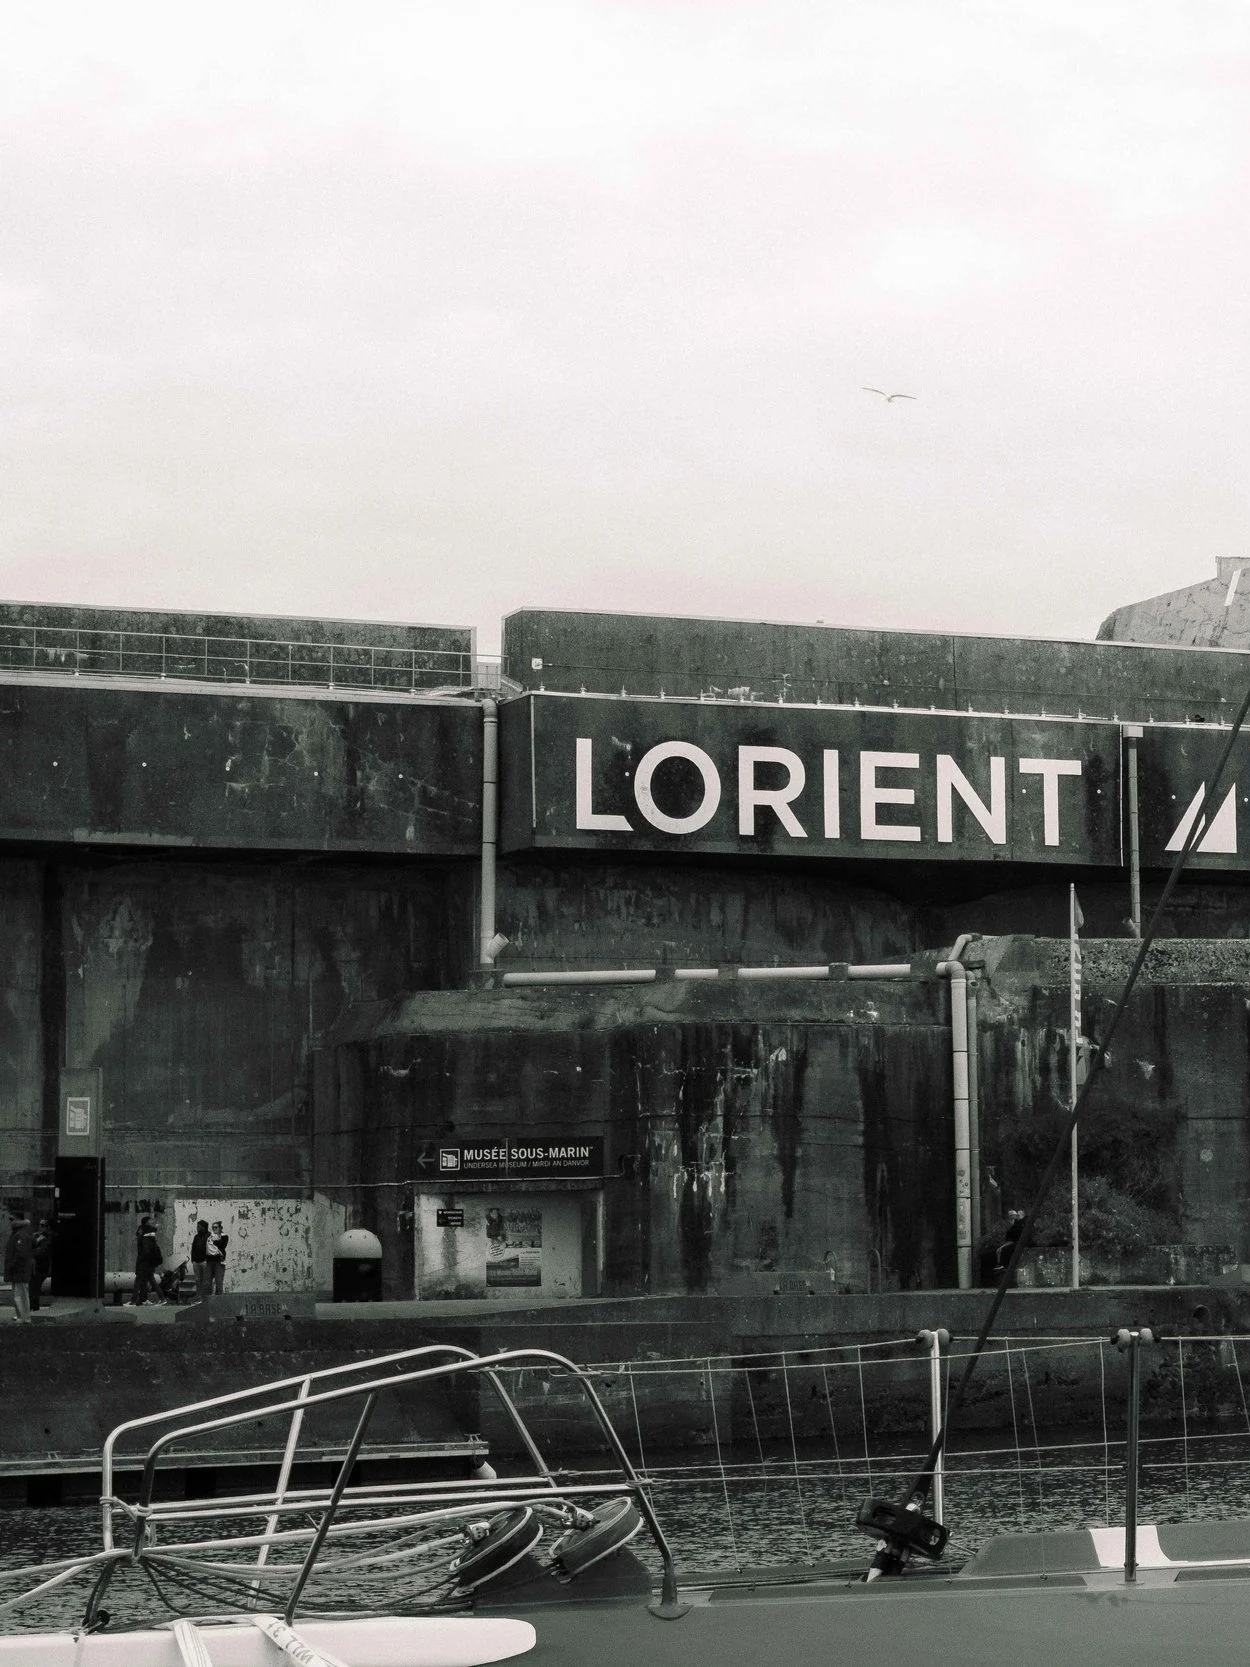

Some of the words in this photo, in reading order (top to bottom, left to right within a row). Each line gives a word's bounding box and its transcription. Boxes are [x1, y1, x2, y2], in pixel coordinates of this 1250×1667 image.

[576, 738, 1082, 846] LORIENT
[464, 1147, 507, 1160] MUSÉE
[464, 1161, 497, 1169] UNDERSEA
